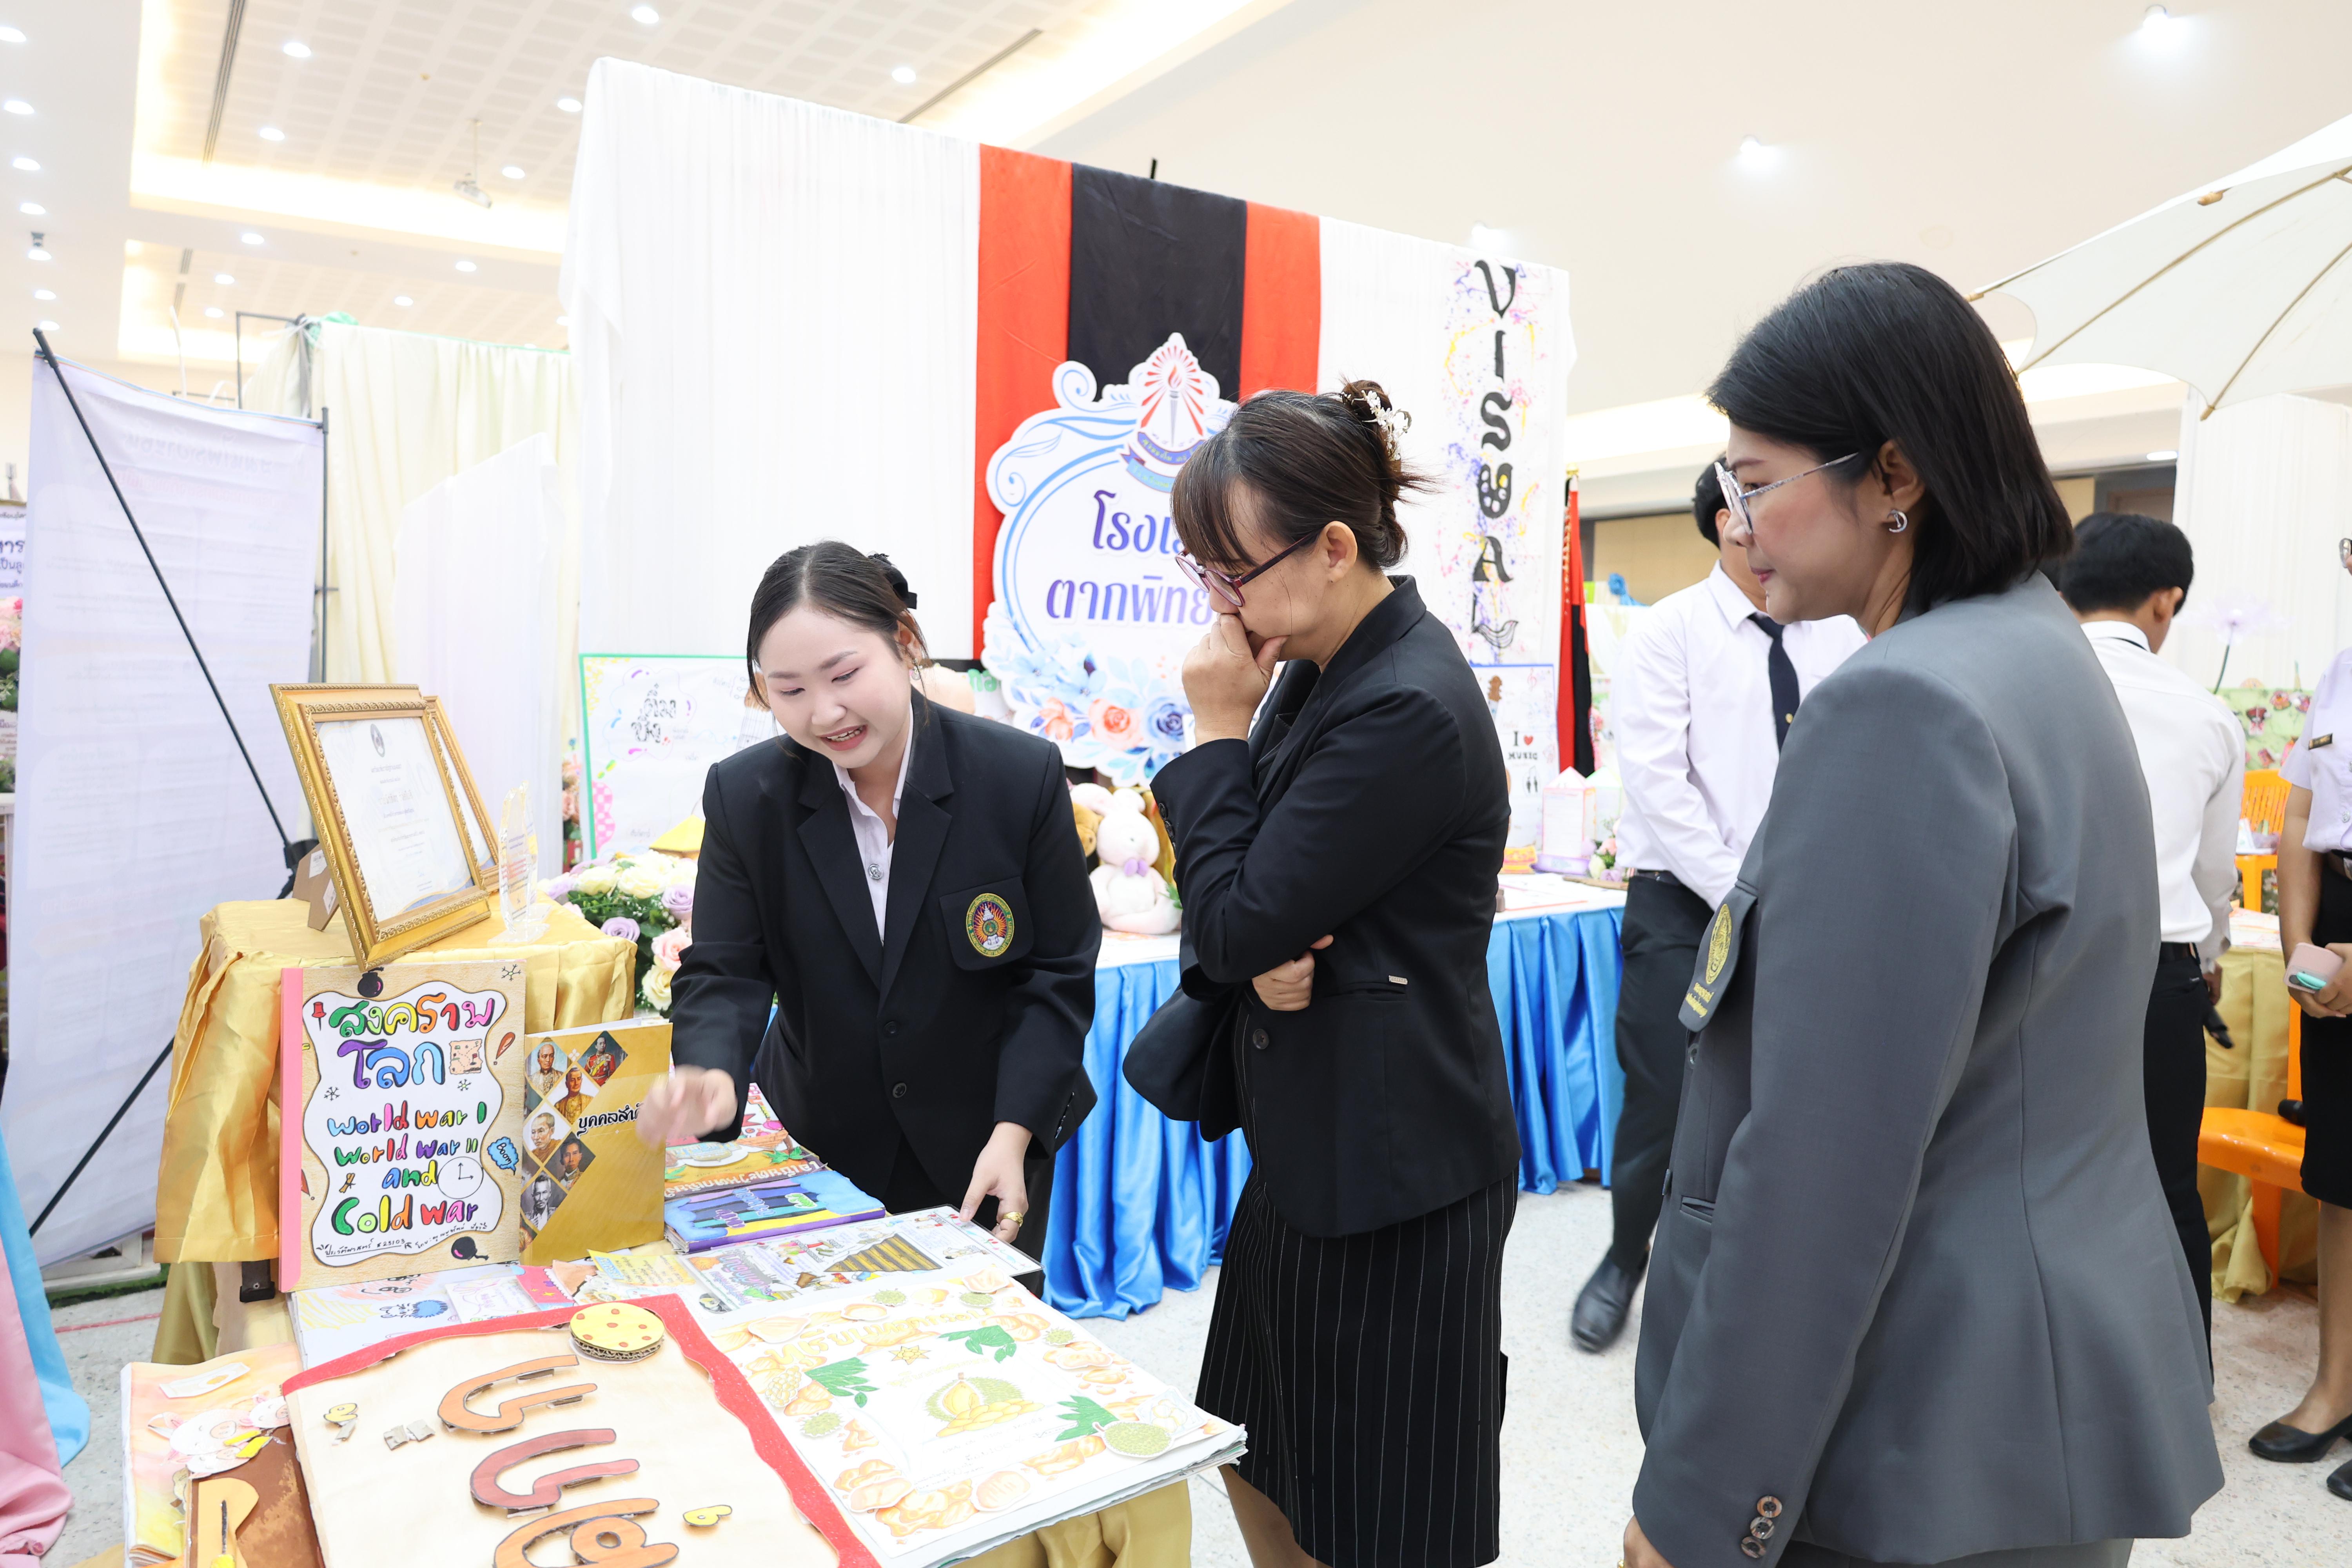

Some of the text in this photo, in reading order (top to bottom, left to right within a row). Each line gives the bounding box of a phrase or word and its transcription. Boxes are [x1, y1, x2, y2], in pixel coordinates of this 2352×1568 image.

[1093, 489, 1184, 555] โรงเ
[329, 992, 494, 1038] สงคราม
[338, 1039, 446, 1090] โลก
[381, 1160, 438, 1190] and
[330, 1195, 413, 1236] Cold
